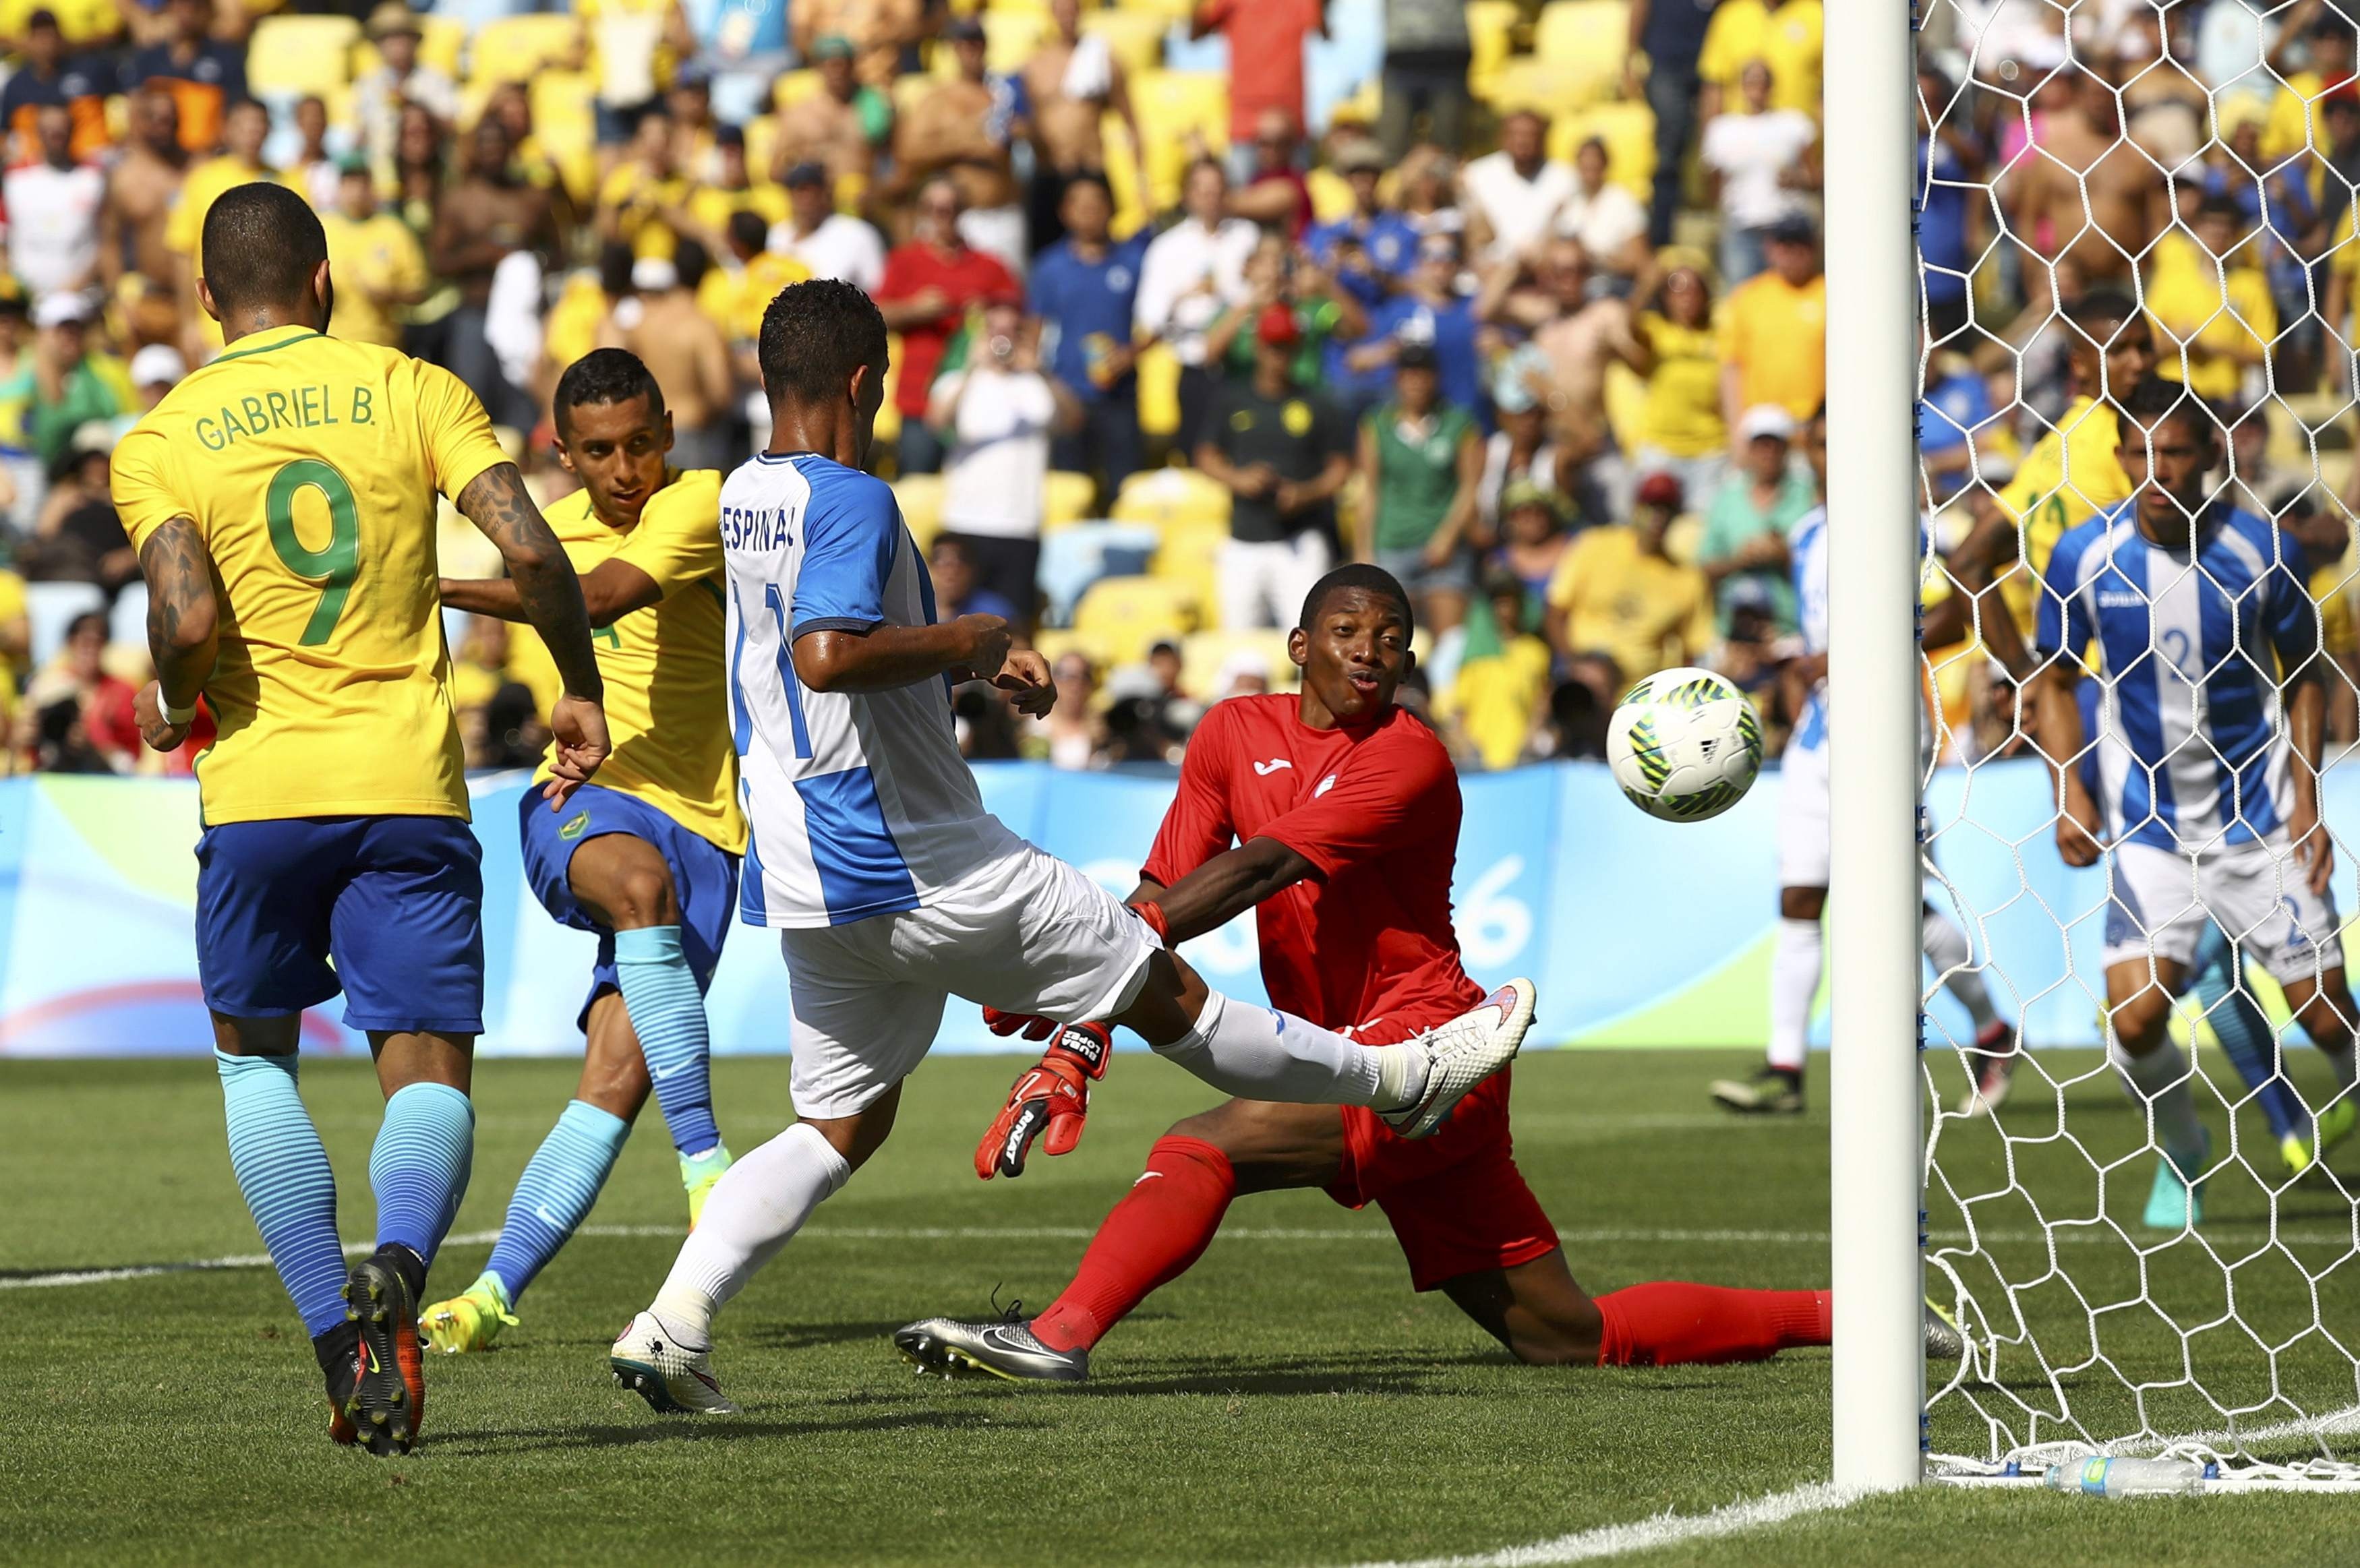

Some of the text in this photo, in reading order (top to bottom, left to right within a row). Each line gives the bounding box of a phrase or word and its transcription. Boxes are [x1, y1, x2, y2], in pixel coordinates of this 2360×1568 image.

[196, 384, 376, 451] GABRIEL B.
[266, 458, 360, 646] 9
[723, 506, 796, 551] ESPINAL
[732, 578, 813, 759] 11
[2162, 626, 2195, 680] 2
[2274, 893, 2310, 946] 2
[1061, 1037, 1097, 1061] BUBA
[1063, 1030, 1100, 1054] LOPEZ
